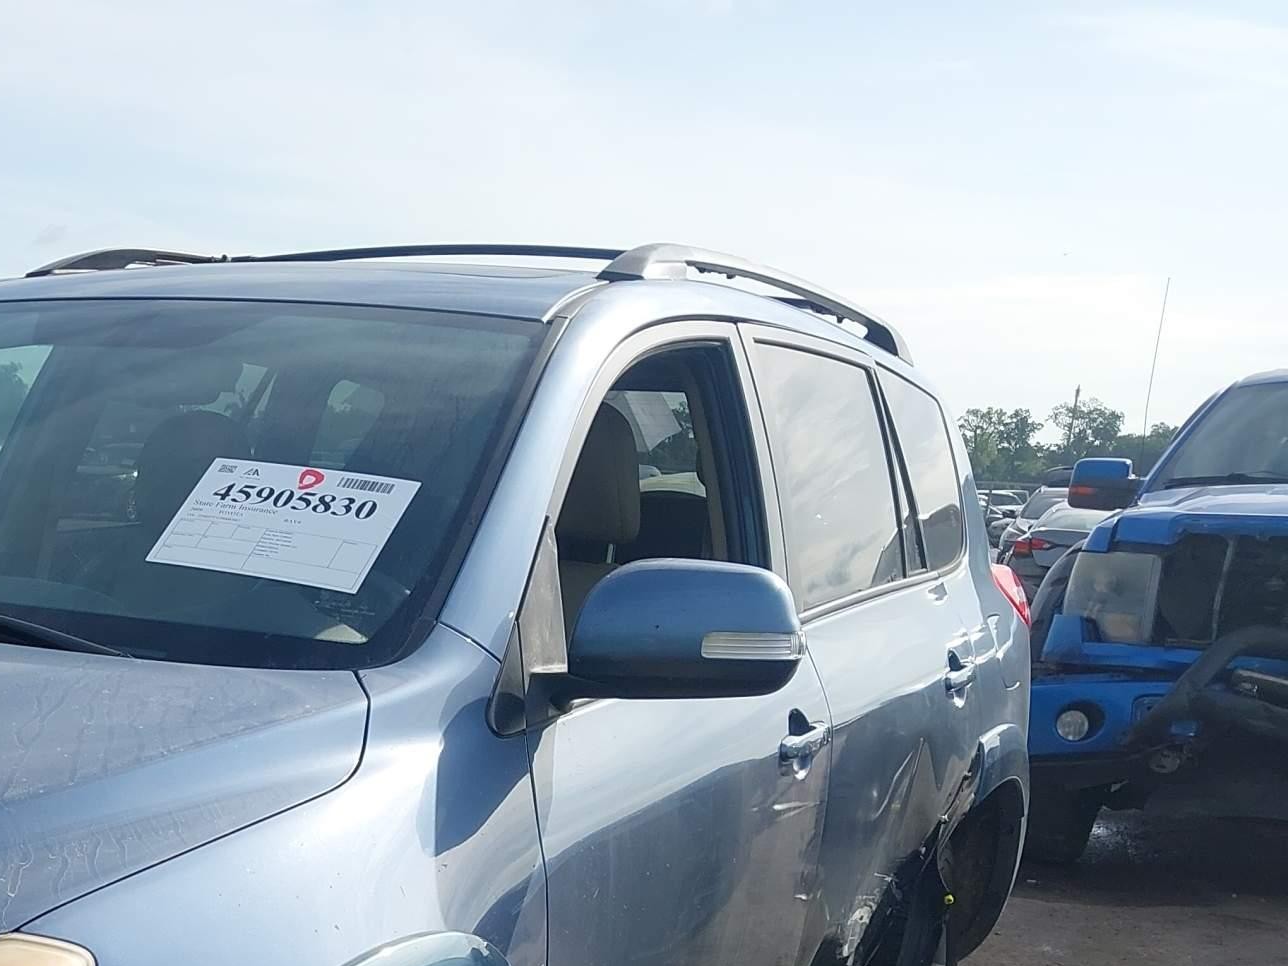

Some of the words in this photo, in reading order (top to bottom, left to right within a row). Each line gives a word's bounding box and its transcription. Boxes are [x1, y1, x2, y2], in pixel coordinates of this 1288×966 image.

[193, 499, 213, 508] State
[215, 501, 237, 510] Farm
[238, 503, 279, 515] Insurance
[213, 482, 378, 520] 45905830
